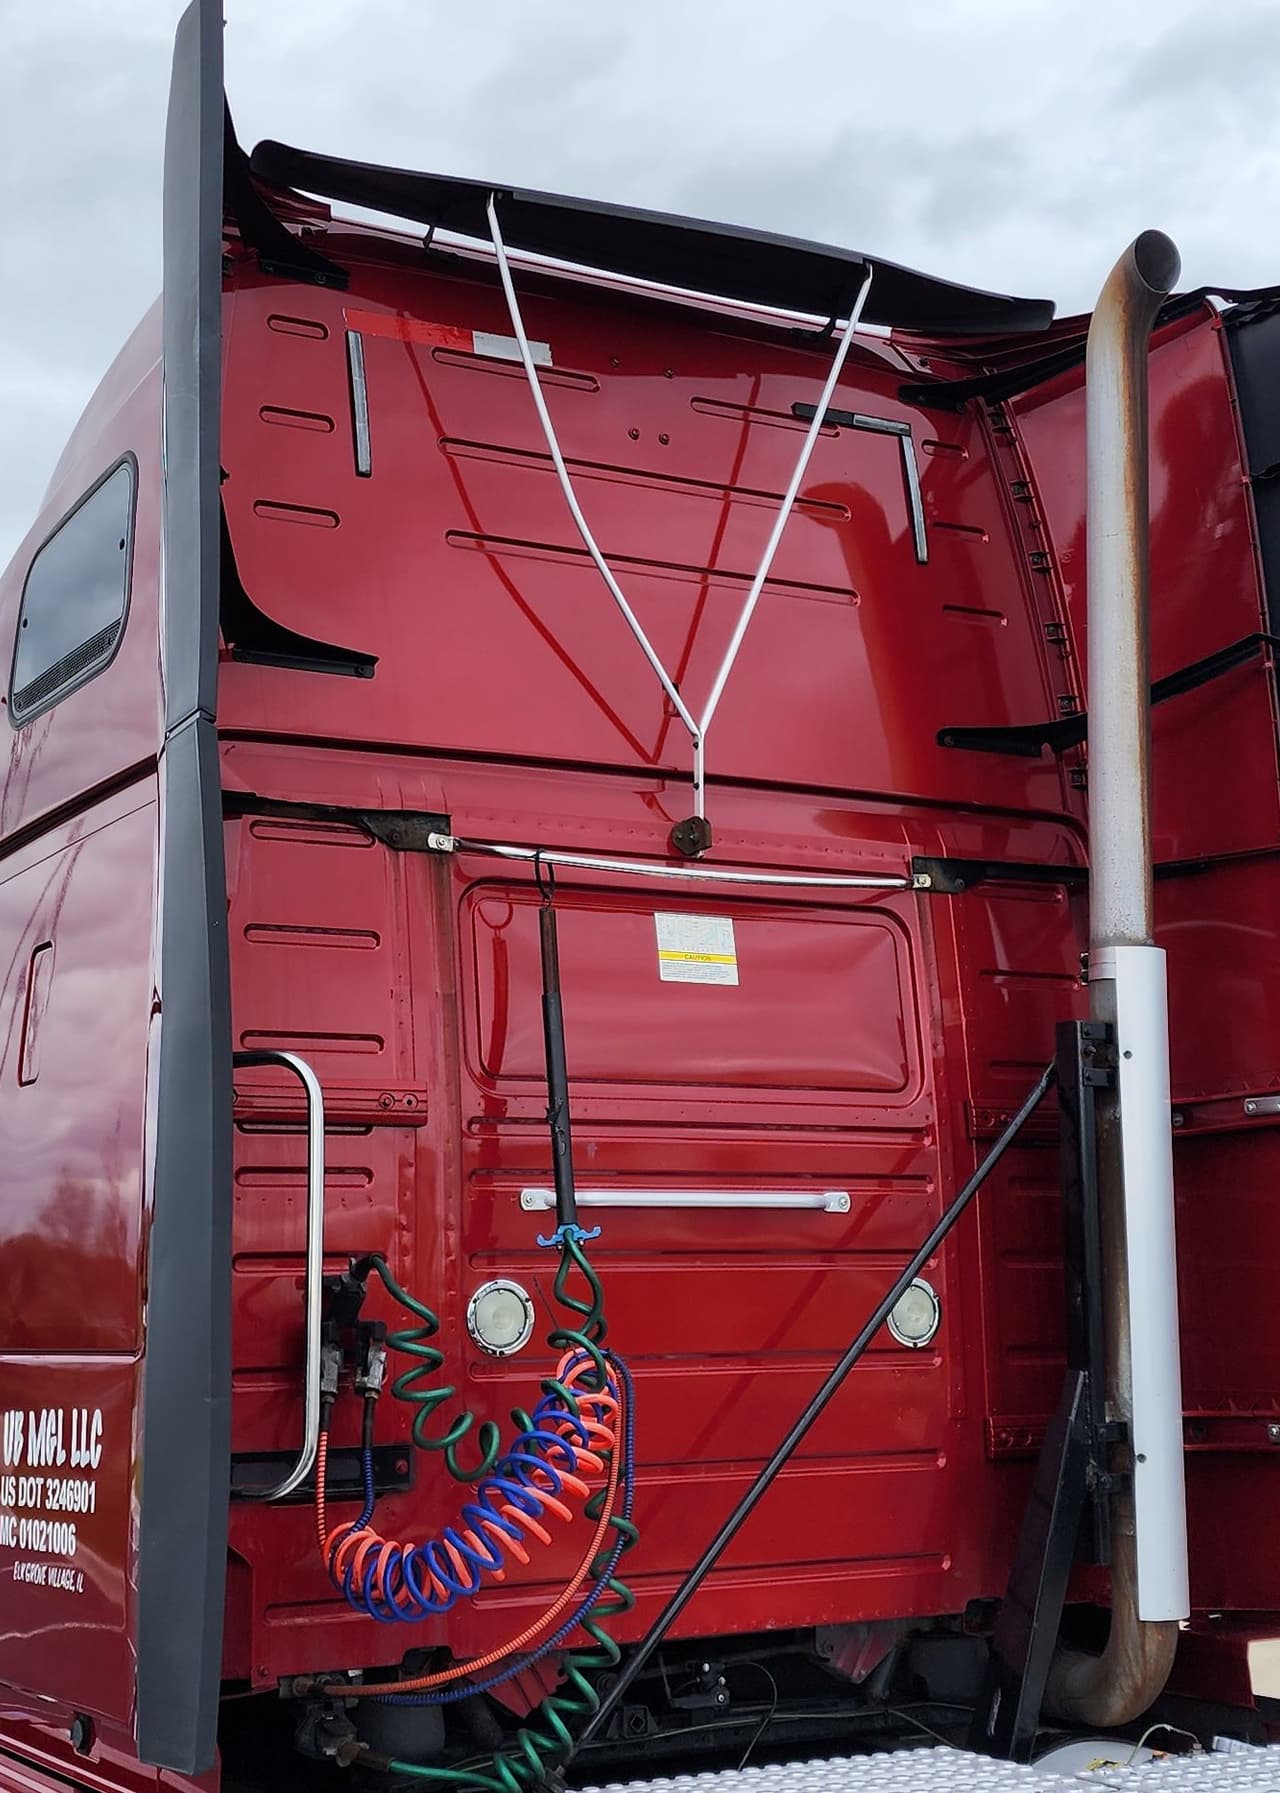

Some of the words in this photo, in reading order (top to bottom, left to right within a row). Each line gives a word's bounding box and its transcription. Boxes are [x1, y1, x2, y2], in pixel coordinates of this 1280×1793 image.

[27, 1408, 67, 1468] MGL
[70, 1407, 103, 1469] LLC
[0, 1475, 17, 1507] US
[17, 1476, 45, 1509] DOT
[45, 1478, 97, 1514] 3246901
[0, 1514, 18, 1548] MC
[19, 1517, 77, 1556] 01021006
[13, 1560, 26, 1581] ELK
[25, 1562, 48, 1586] GROVE
[48, 1566, 76, 1593] VILLAGE,
[76, 1571, 85, 1593] IL
